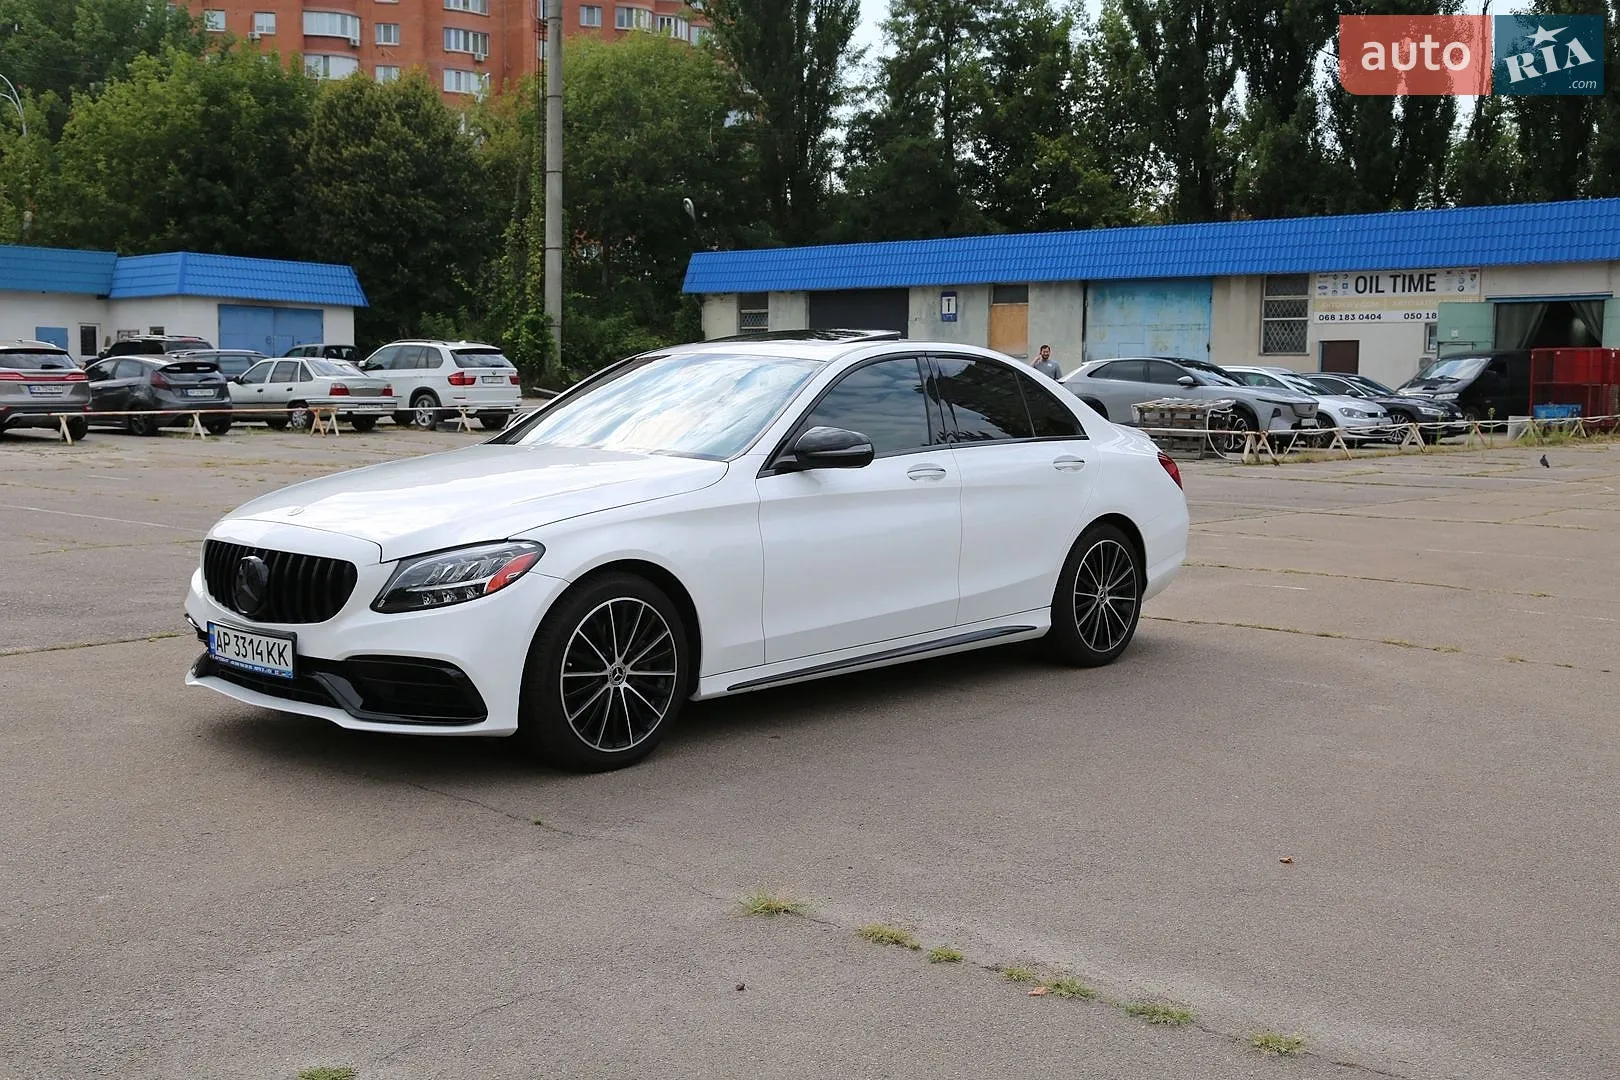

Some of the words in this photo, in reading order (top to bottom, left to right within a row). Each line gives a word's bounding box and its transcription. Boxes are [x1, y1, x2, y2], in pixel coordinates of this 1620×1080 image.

[1355, 275, 1384, 294] OIL
[1389, 273, 1437, 293] TIME
[1339, 313, 1356, 321] 183
[1358, 313, 1382, 321] 0404
[1403, 312, 1422, 320] 050
[1425, 312, 1437, 320] 18
[216, 630, 231, 654] AP
[233, 634, 264, 663] 3314
[266, 640, 289, 667] KK
